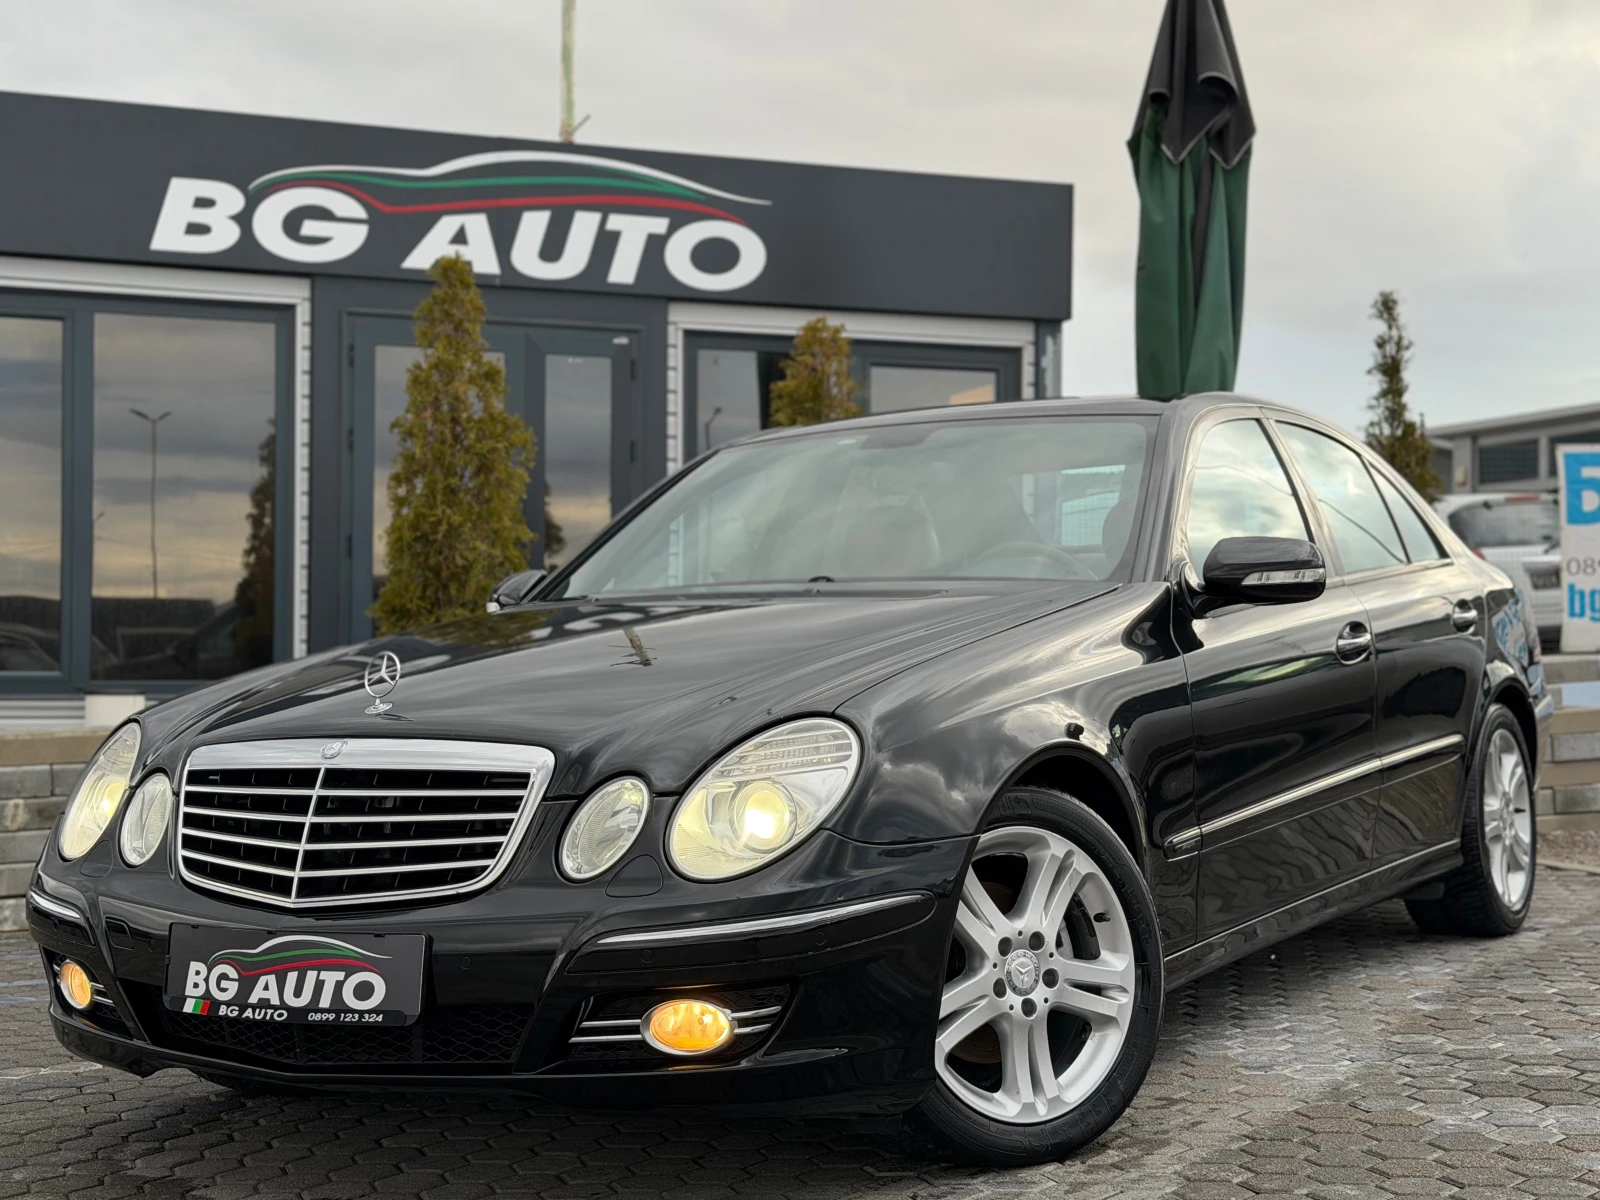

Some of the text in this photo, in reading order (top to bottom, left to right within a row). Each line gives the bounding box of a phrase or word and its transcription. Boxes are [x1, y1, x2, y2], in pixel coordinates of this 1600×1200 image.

[150, 176, 767, 291] BG AUTO
[1566, 556, 1600, 577] 08
[184, 960, 387, 1011] BG AUTO
[218, 1004, 288, 1021] BG AUTO
[307, 1012, 383, 1022] 0899 123 324
